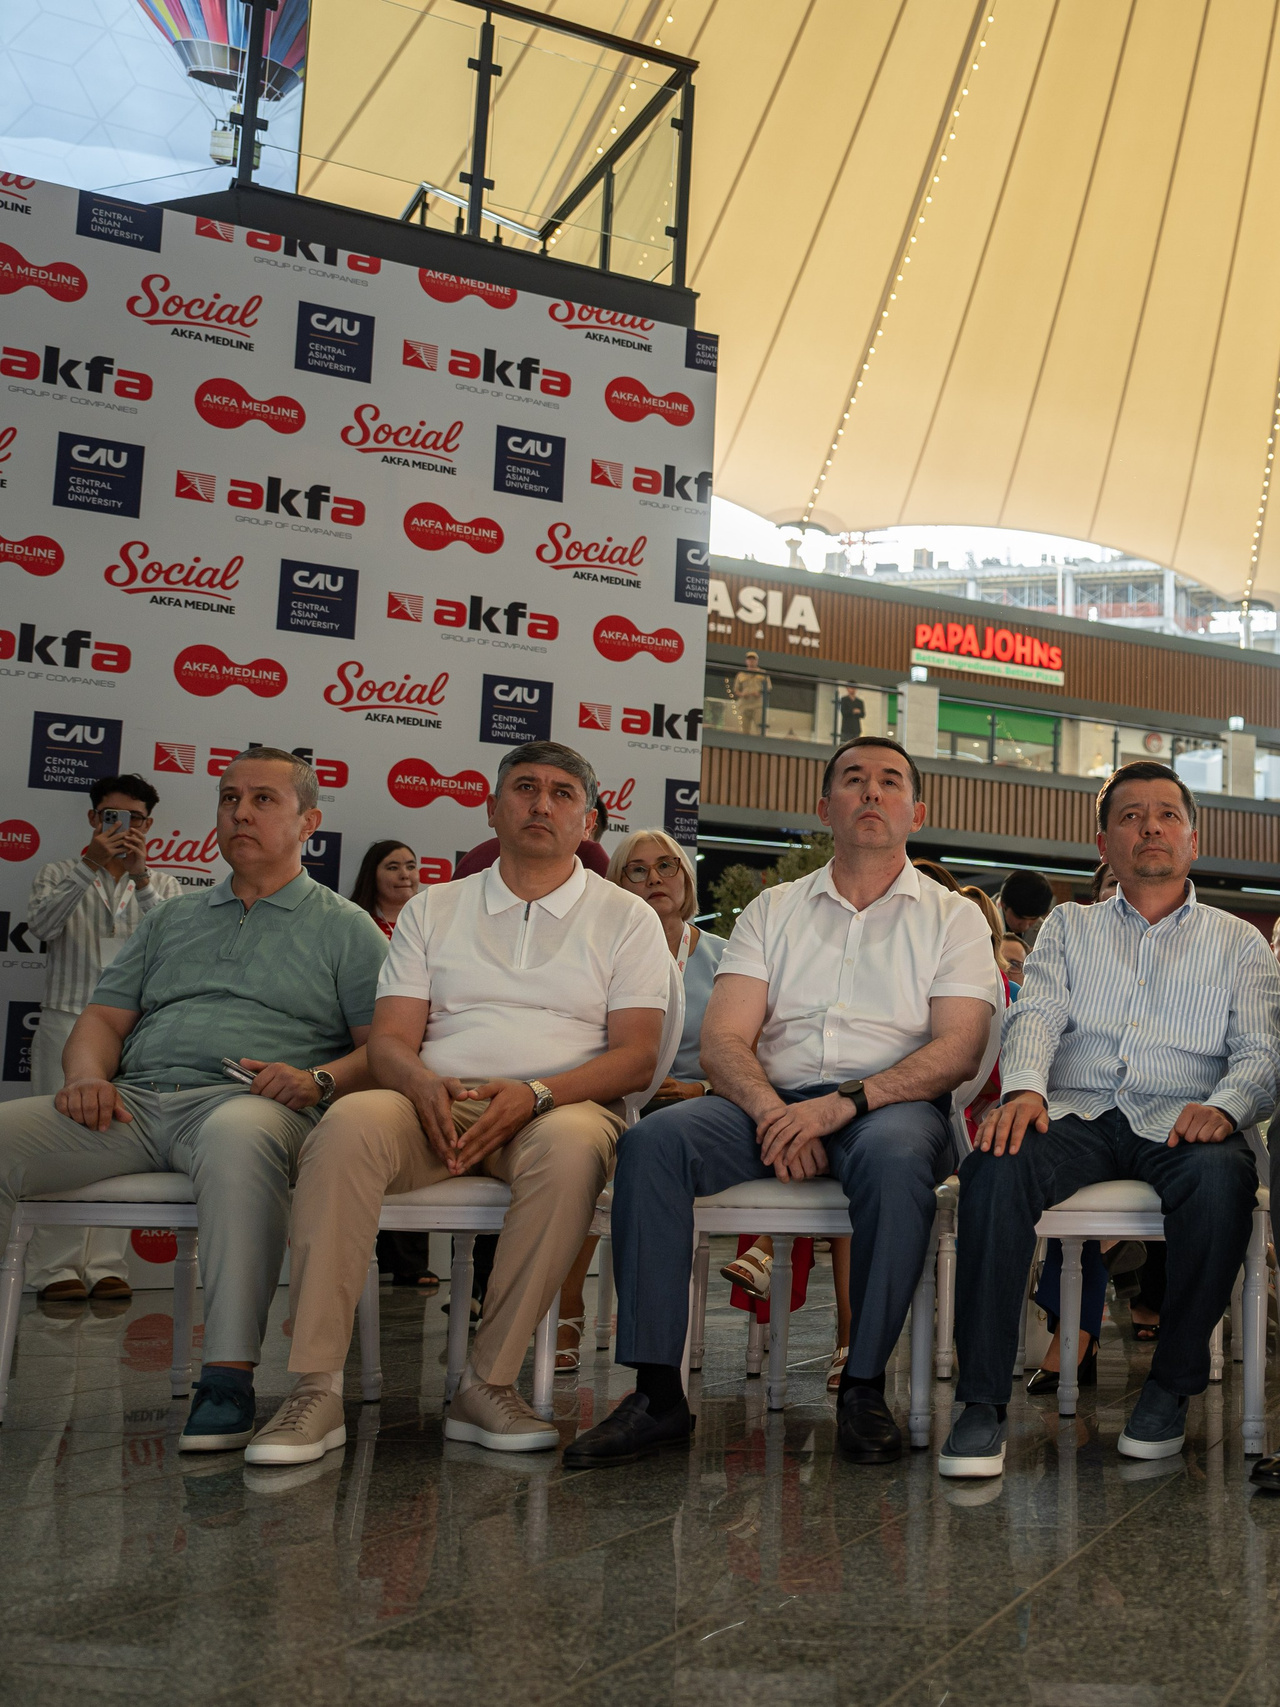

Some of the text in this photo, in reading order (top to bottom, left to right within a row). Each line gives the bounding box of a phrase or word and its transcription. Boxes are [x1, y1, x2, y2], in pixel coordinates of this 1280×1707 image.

[0, 201, 32, 215] LINE
[92, 208, 133, 223] CENTRAL
[91, 217, 121, 228] ASIAN
[91, 224, 144, 241] UNIVERSITY
[17, 265, 79, 286] MEDLINE
[254, 256, 369, 287] GROUP OF COMPANIES
[426, 269, 511, 295] AKFA MEDLINE
[126, 274, 263, 327] Social
[310, 312, 360, 336] CAU
[171, 327, 255, 352] AKFA MEDLINE
[309, 342, 347, 356] CENTRAL
[585, 332, 652, 353] AKFA MEDLINE
[308, 351, 335, 361] ASIAN
[0, 345, 153, 401] akfa
[308, 359, 356, 374] UNIVERSITY
[448, 348, 572, 398] akfa
[8, 385, 138, 415] GROUP OF COMPANIES
[203, 393, 298, 419] AKFA MEDLINE
[455, 384, 489, 395] GROUP
[505, 393, 559, 410] COMPANIES
[611, 390, 689, 413] AKFA MEDLINE
[341, 403, 464, 453] Social
[71, 444, 128, 468] CAU
[507, 436, 552, 458] CAU
[381, 455, 457, 476] AKFA MEDLINE
[506, 465, 540, 477] CENTRAL
[69, 476, 112, 490] CENTRAL
[505, 480, 549, 494] UNIVERSITY
[506, 473, 530, 482] ASIAN
[632, 464, 713, 504] akf
[68, 485, 98, 496] ASIAN
[68, 493, 123, 508] UNIVERSITY
[227, 476, 366, 527] akfa
[639, 500, 670, 510] GROUP
[671, 504, 683, 512] OF
[235, 515, 352, 540] GROUP OF COMPANIES
[411, 517, 498, 539] AKFA MEDLINE
[535, 522, 647, 567] Social
[104, 540, 244, 591] Social
[292, 570, 343, 592] CAU
[573, 571, 642, 589] AKFA MEDLINE
[685, 576, 709, 585] CENTR
[685, 584, 707, 592] ASIAN
[150, 595, 235, 615] AKFA MEDLINE
[290, 609, 318, 619] ASIAN
[291, 601, 330, 613] CENTRAL
[290, 617, 340, 631] UNIVERSITY
[433, 595, 559, 641] akfa
[441, 633, 475, 643] GROUP
[492, 641, 547, 654] COMPANIES
[600, 629, 679, 649] AKFA MEDLINE
[709, 622, 732, 634] SHI
[788, 634, 820, 648] WOK
[915, 622, 1063, 670] PAPA JOHNS
[182, 661, 280, 681] AKFA MEDLINE
[915, 653, 945, 665] Better
[1005, 667, 1033, 678] Better
[28, 671, 44, 679] OF
[46, 674, 116, 689] COMPANIES
[323, 661, 450, 706] Social
[493, 684, 540, 704] CAU
[365, 712, 442, 729] AKFA MEDLINE
[492, 713, 527, 725] CENTRAL
[492, 722, 517, 731] ASIAN
[621, 703, 703, 741] akf
[47, 722, 105, 745] CAU
[491, 730, 536, 741] UNIVERSITY
[628, 741, 659, 750] GROUP
[44, 766, 75, 775] ASIAN
[45, 756, 89, 768] CENTRAL
[395, 774, 483, 792] AKFA MEDLINE
[609, 823, 629, 833] LINE
[674, 825, 697, 833] ASIAN
[675, 817, 698, 826] CENTR
[0, 832, 31, 843] LINE
